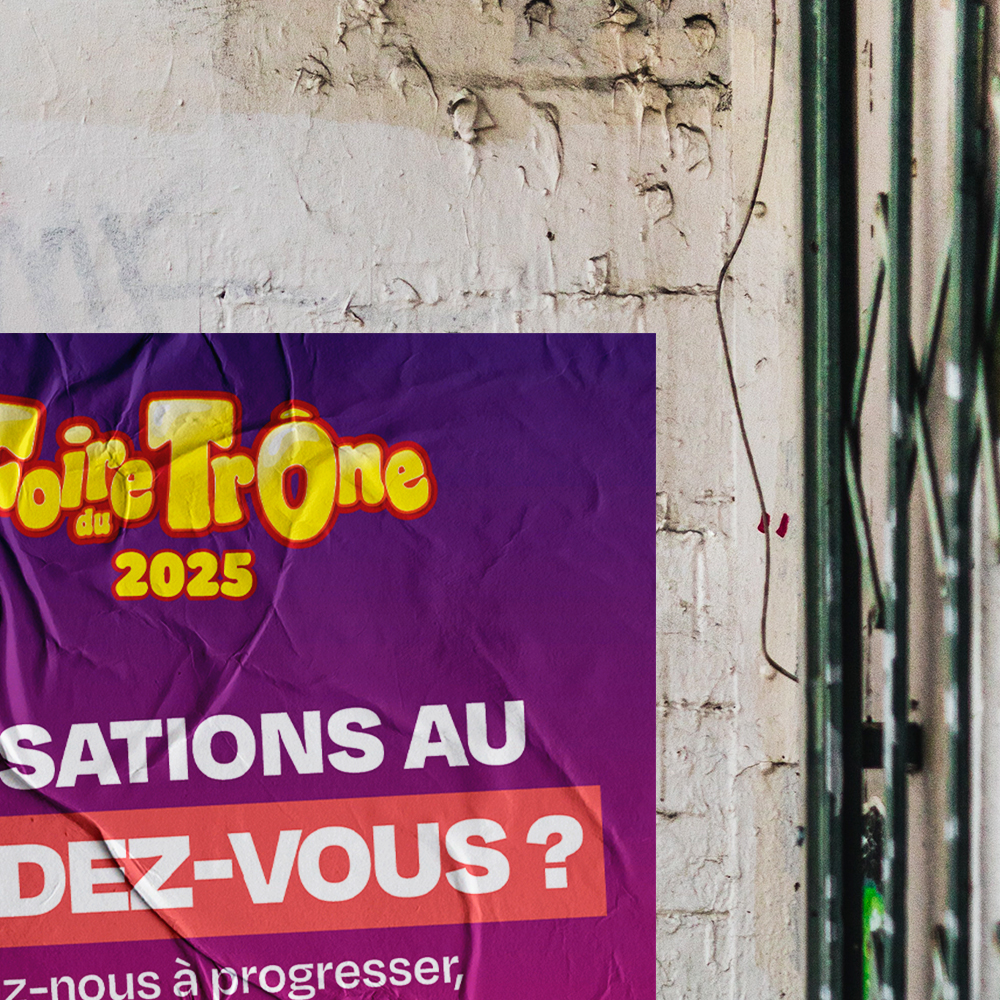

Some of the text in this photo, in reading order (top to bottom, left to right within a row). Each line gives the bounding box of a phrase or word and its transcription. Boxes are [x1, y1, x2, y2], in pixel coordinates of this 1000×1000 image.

[73, 507, 113, 538] du
[113, 550, 256, 600] 2025
[403, 699, 526, 770] AU
[173, 957, 198, 998] à
